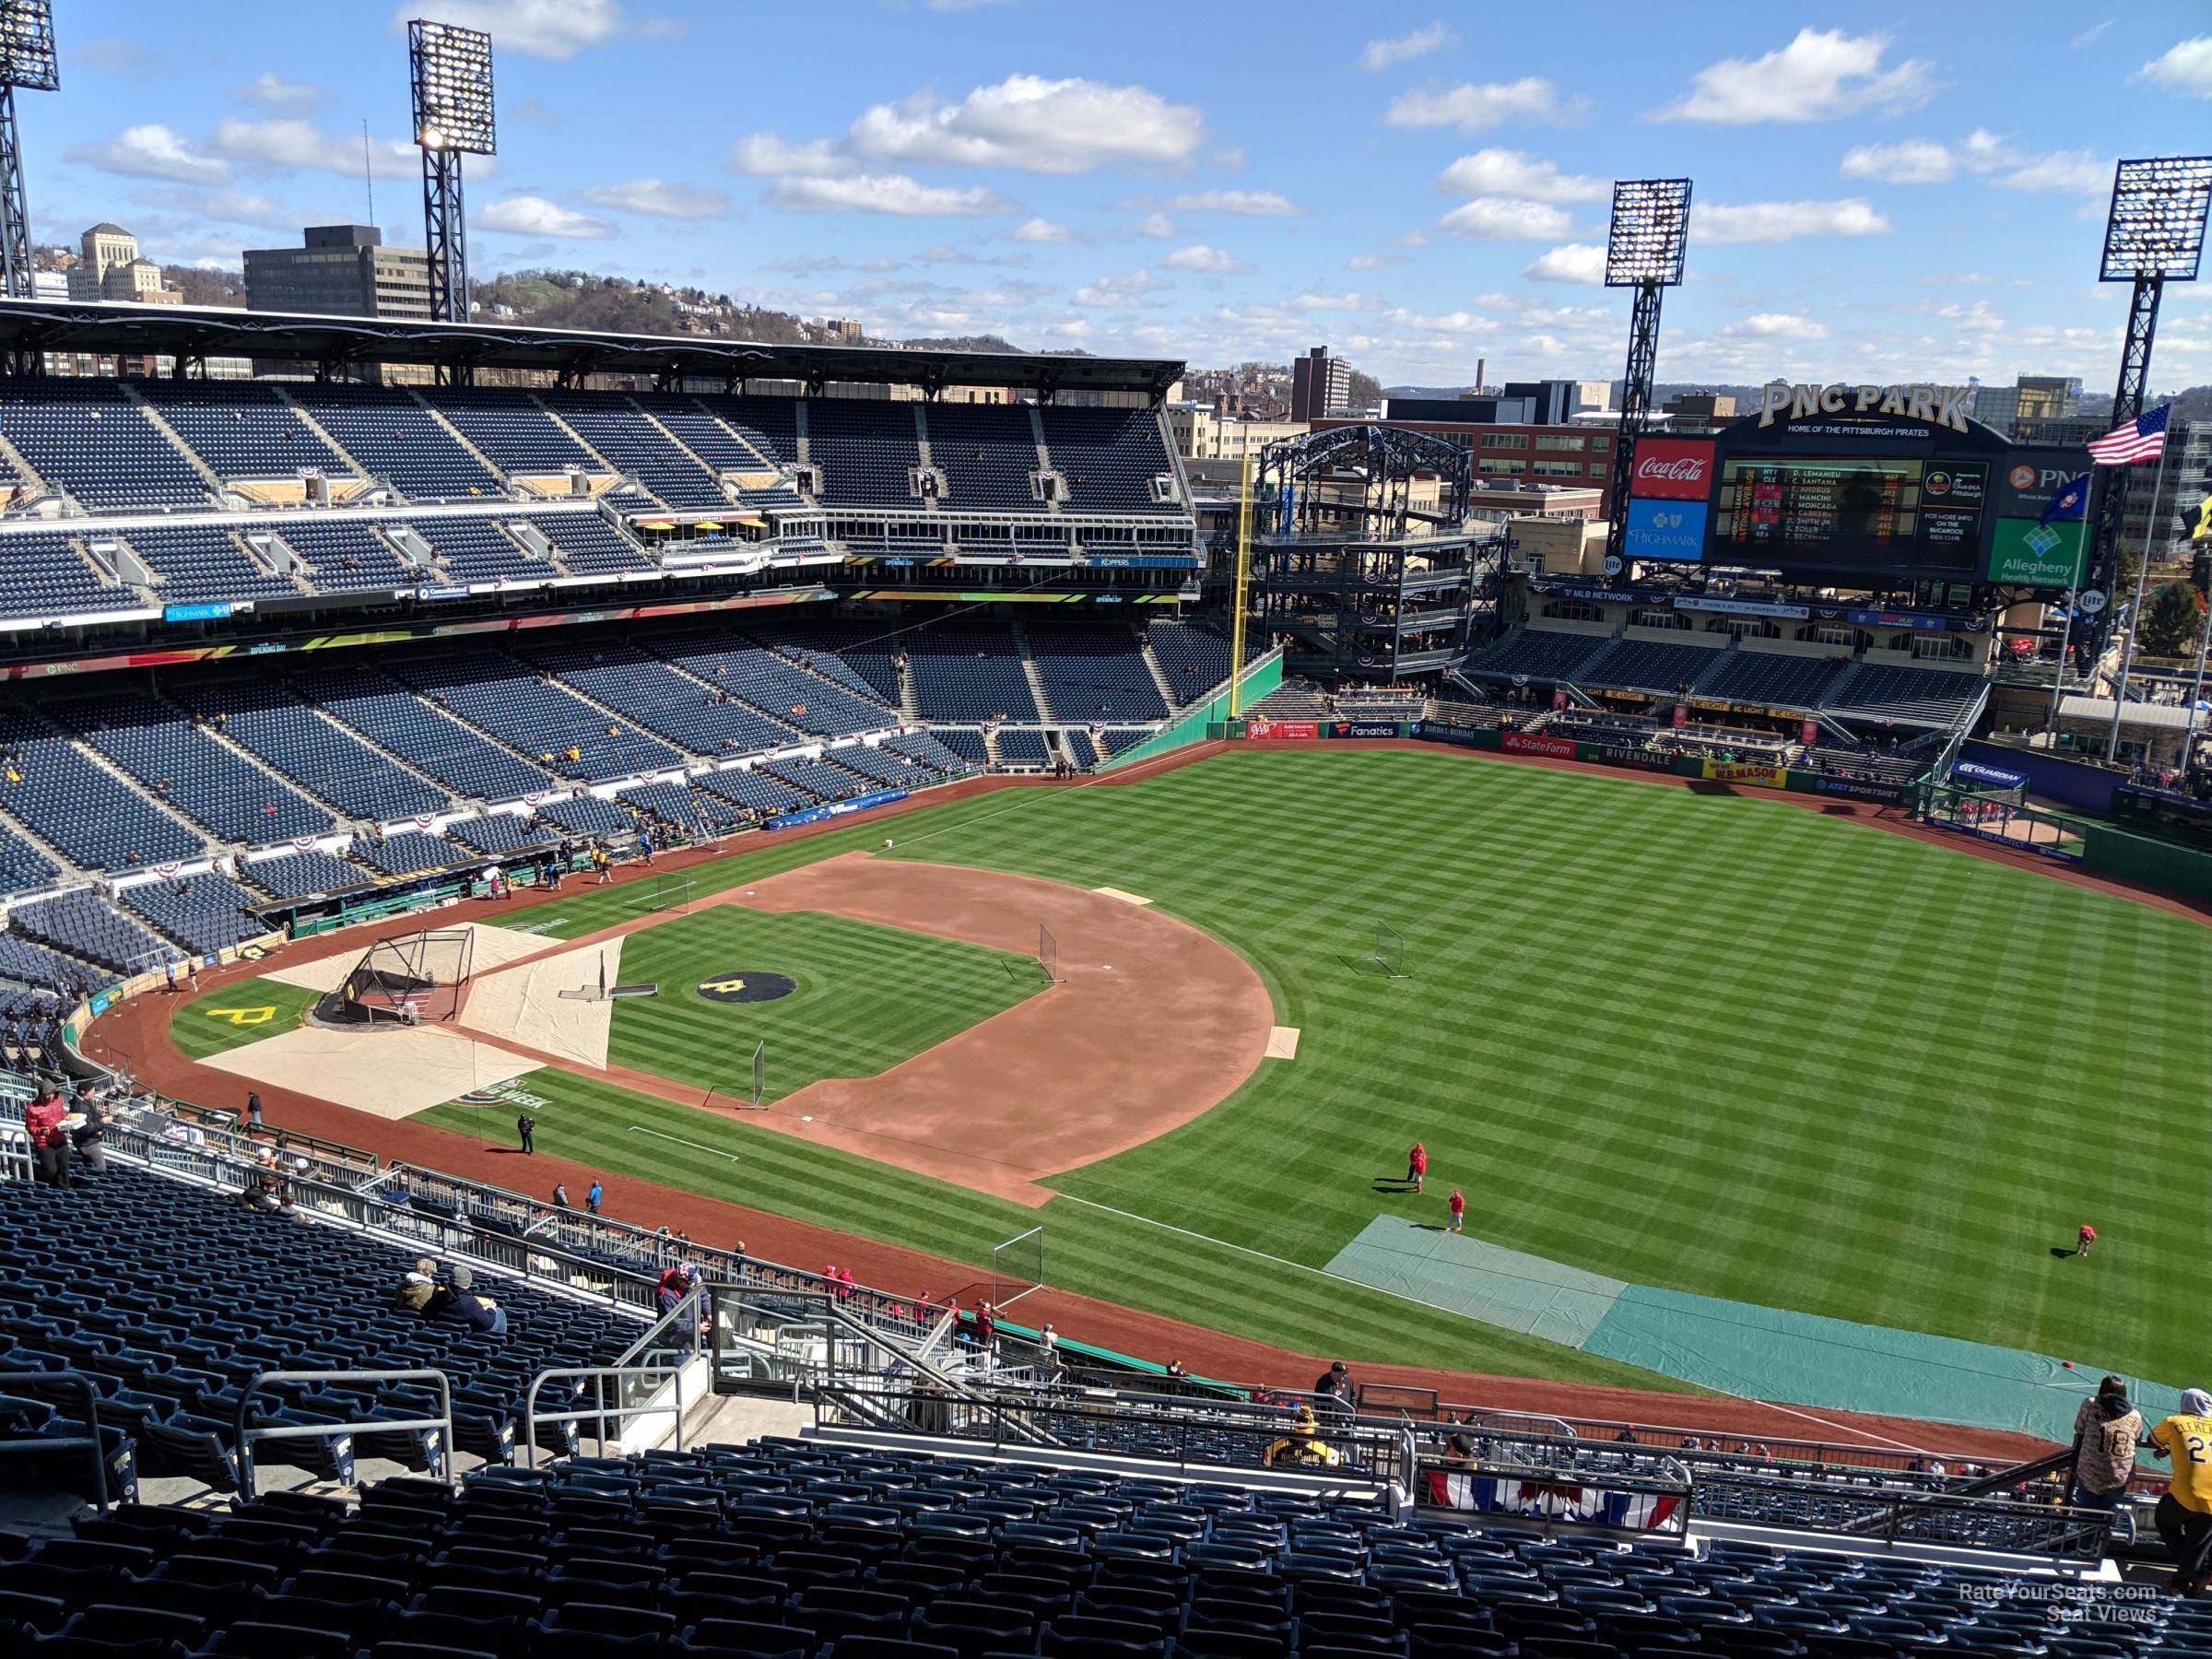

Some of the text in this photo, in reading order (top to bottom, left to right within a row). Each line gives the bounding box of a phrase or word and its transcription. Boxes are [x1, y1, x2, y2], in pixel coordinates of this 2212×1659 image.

[1759, 383, 1970, 433] PNC PARK
[1788, 425, 1811, 433] HOME
[1841, 427, 1893, 436] PITTSBURGH
[1895, 429, 1930, 437] PIRATES
[1639, 457, 1707, 480] Coca-Cola
[2040, 469, 2093, 488] PN
[1630, 530, 1701, 547] HIGHMARK
[1100, 558, 1130, 567] KOPPERS
[1605, 559, 1621, 570] Lite
[2003, 559, 2072, 576] Allegheny
[2001, 573, 2069, 585] Health Network
[429, 587, 467, 595] Consolidated
[1572, 590, 1633, 602] MLB NETWORK
[2083, 594, 2104, 606] Lite
[251, 646, 276, 655] OPENING
[276, 644, 287, 653] DAY
[57, 664, 77, 673] PNC
[1619, 691, 1641, 700] LIGHT
[1703, 702, 1725, 711] LIGHT
[1743, 707, 1764, 715] LIGHT
[1783, 712, 1805, 720] LIGHT
[1350, 724, 1394, 737] Fanatics
[1425, 724, 1448, 735] BORDAS
[1450, 727, 1475, 738] BORDAS
[1606, 747, 1672, 765] RIVENDALE
[1974, 766, 2021, 782] GUARDIAN
[1828, 782, 1900, 798] AT&T SPORTSNET
[699, 979, 748, 994] P
[206, 1006, 276, 1025] P
[498, 1089, 553, 1109] WEEK
[2097, 1426, 2131, 1460] 18
[2188, 1435, 2212, 1465] 2
